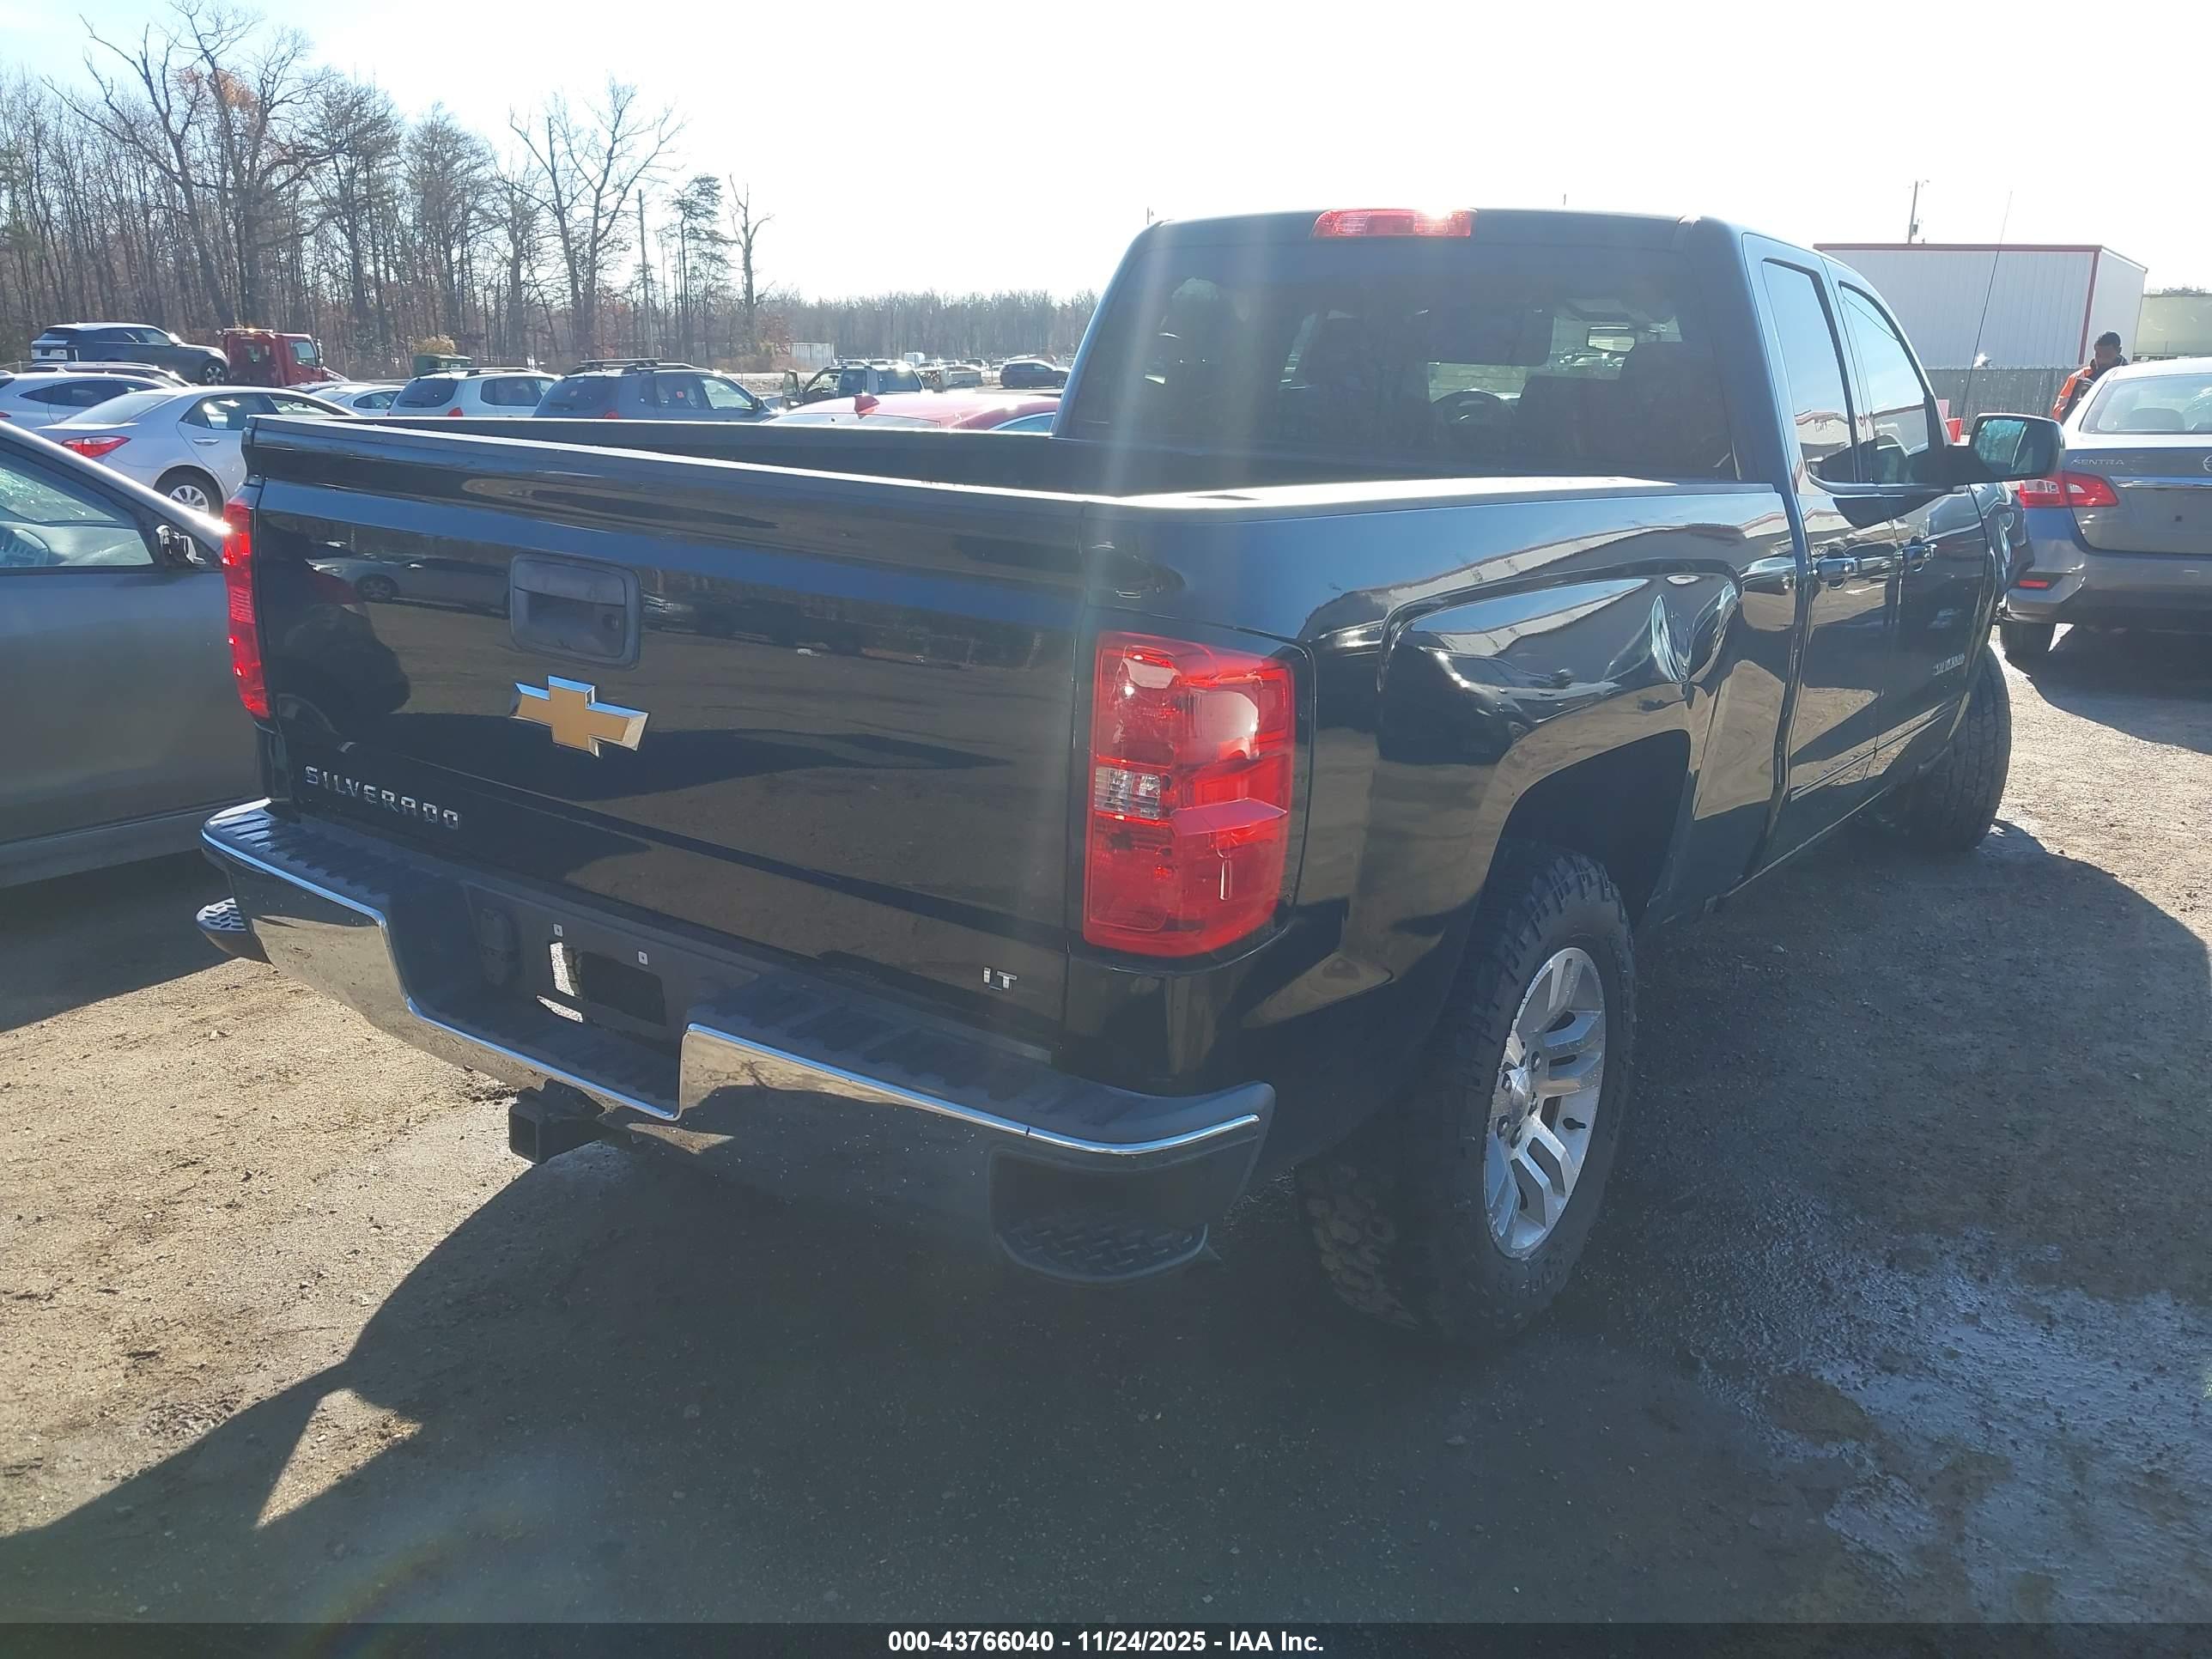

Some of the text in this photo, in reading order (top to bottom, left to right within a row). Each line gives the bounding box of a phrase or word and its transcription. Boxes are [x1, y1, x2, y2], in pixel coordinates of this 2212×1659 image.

[2071, 457, 2124, 465] SENTRA
[305, 766, 460, 830] SILVERADO
[983, 967, 1018, 990] LT
